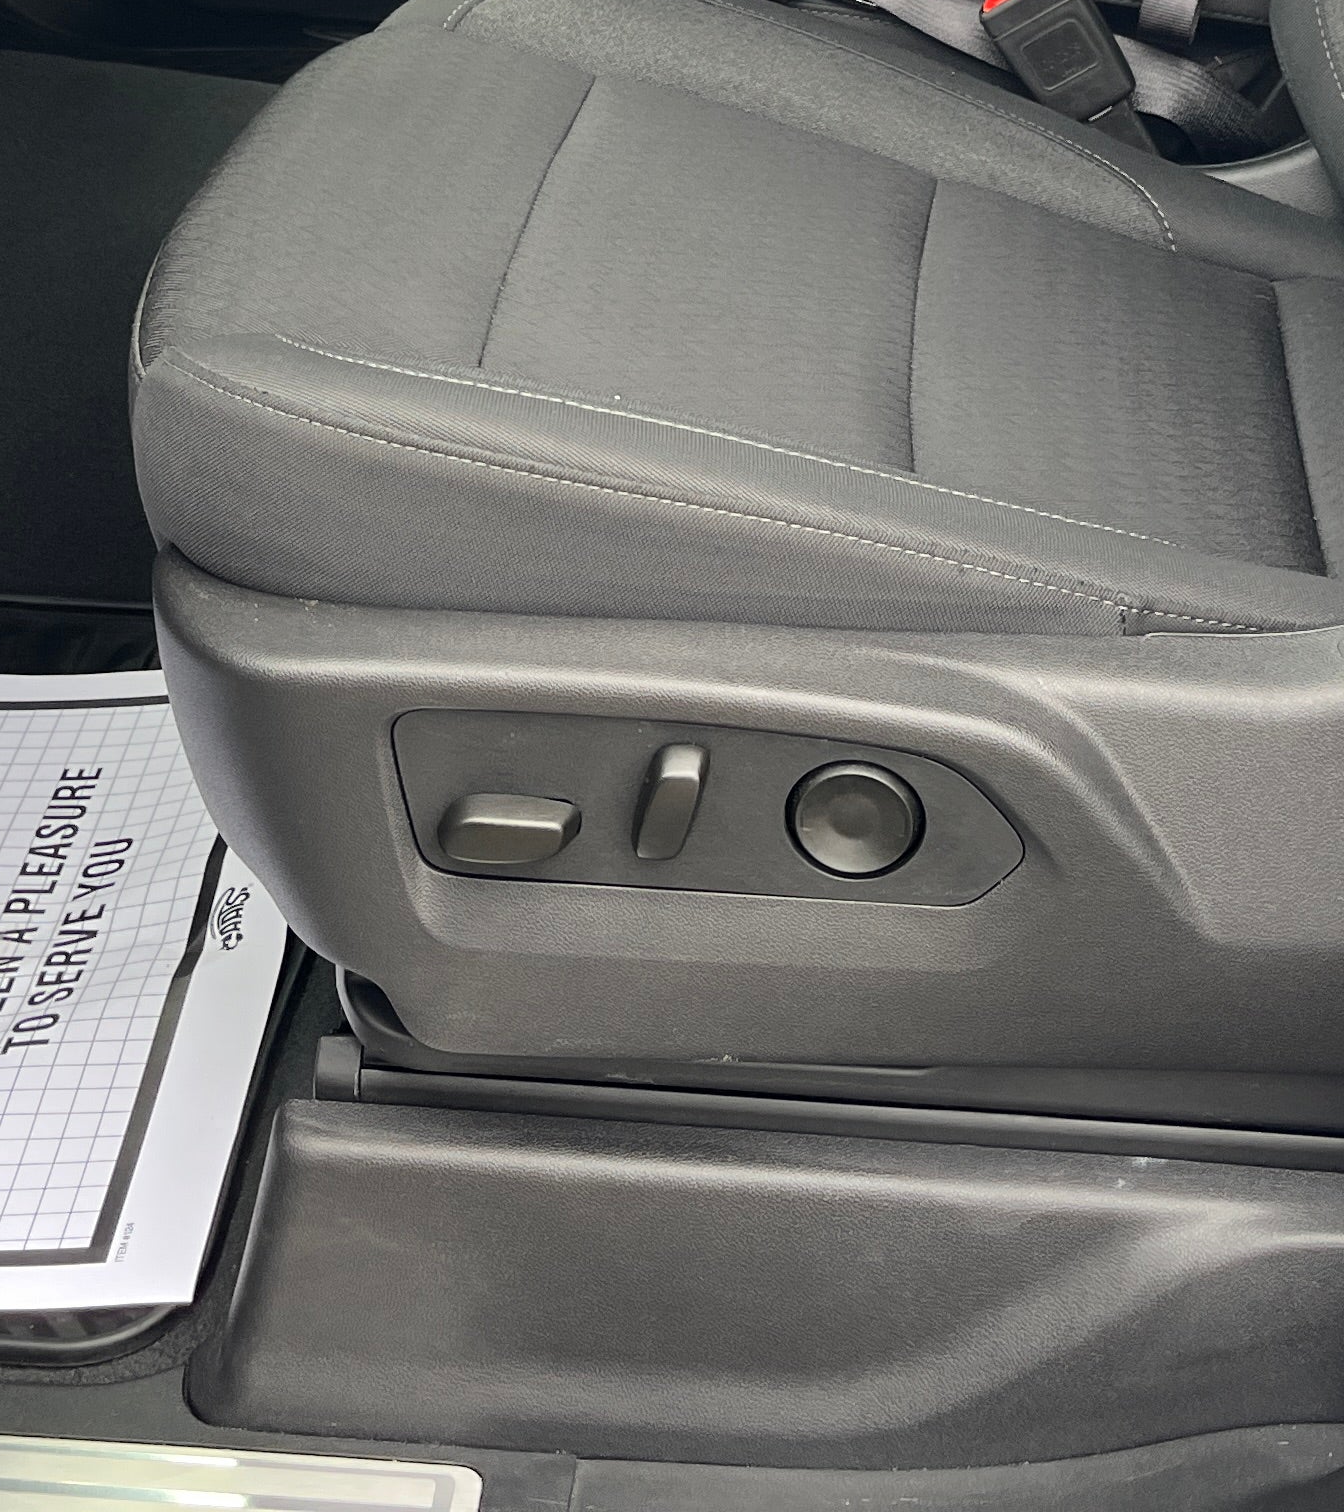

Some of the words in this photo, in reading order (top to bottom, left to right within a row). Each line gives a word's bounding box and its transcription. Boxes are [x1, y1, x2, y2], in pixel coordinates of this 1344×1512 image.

[2, 767, 103, 914] PLEASURE
[71, 837, 134, 901] YOU
[27, 903, 106, 1006] SERVE
[0, 1013, 61, 1055] TO
[114, 1242, 128, 1263] ITEM
